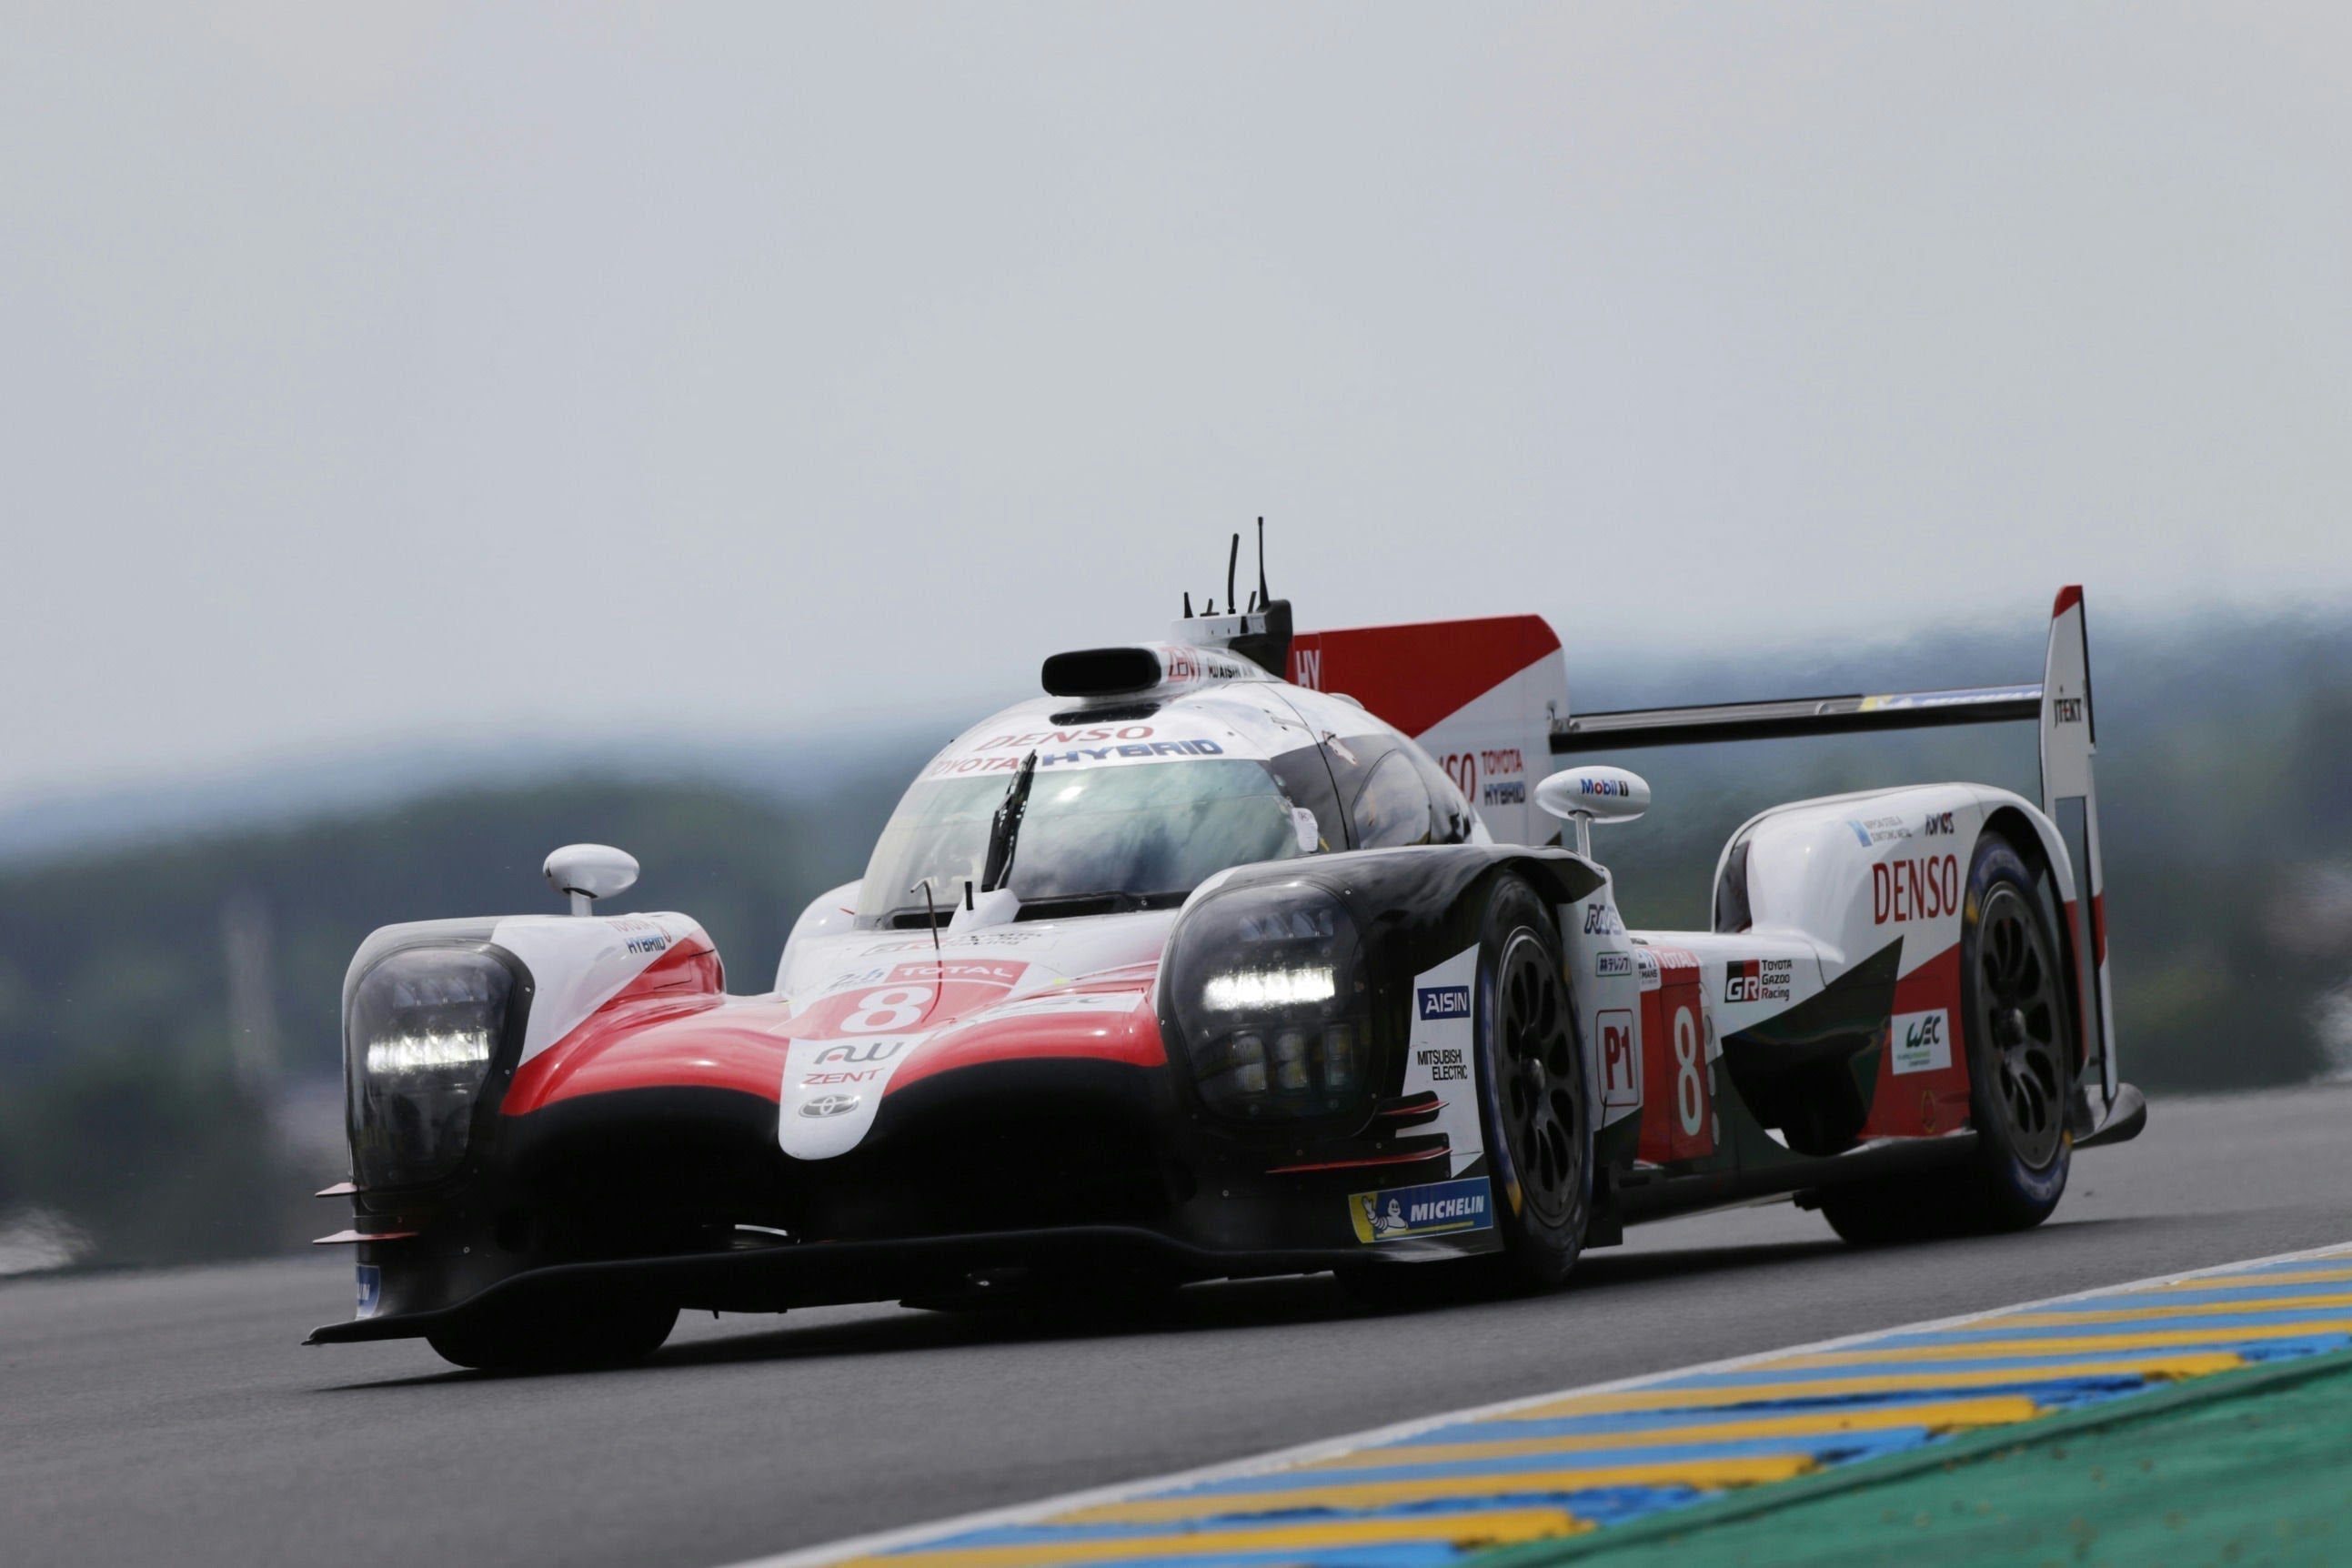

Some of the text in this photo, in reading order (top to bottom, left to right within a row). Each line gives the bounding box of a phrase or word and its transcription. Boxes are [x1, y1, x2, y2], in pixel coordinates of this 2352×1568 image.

[973, 726, 1154, 753] DENSO
[931, 739, 1224, 776] TOYOTA HYBRID
[1481, 749, 1523, 775] TOYOTA
[1483, 781, 1527, 807] HYBRID
[1580, 778, 1617, 796] Mobil
[1872, 853, 1959, 926] DENSO
[1583, 903, 1623, 936] RAYS
[624, 935, 667, 954] HYBRID
[899, 965, 1014, 979] TOTAL
[1761, 960, 1793, 971] TOYOTA
[1726, 975, 1759, 1001] GR
[1761, 973, 1791, 985] GAZOO
[1425, 992, 1468, 1014] AISIN
[1761, 987, 1790, 1001] Racing
[839, 986, 933, 1033] 8
[1906, 1015, 1942, 1049] WEC
[1417, 1049, 1462, 1066] MITSUBISHI
[1603, 1025, 1633, 1091] P1
[801, 1067, 885, 1085] ZENT
[1432, 1065, 1468, 1081] ELECTRIC
[1674, 1005, 1704, 1137] 8
[1410, 1194, 1485, 1223] MICHELIN
